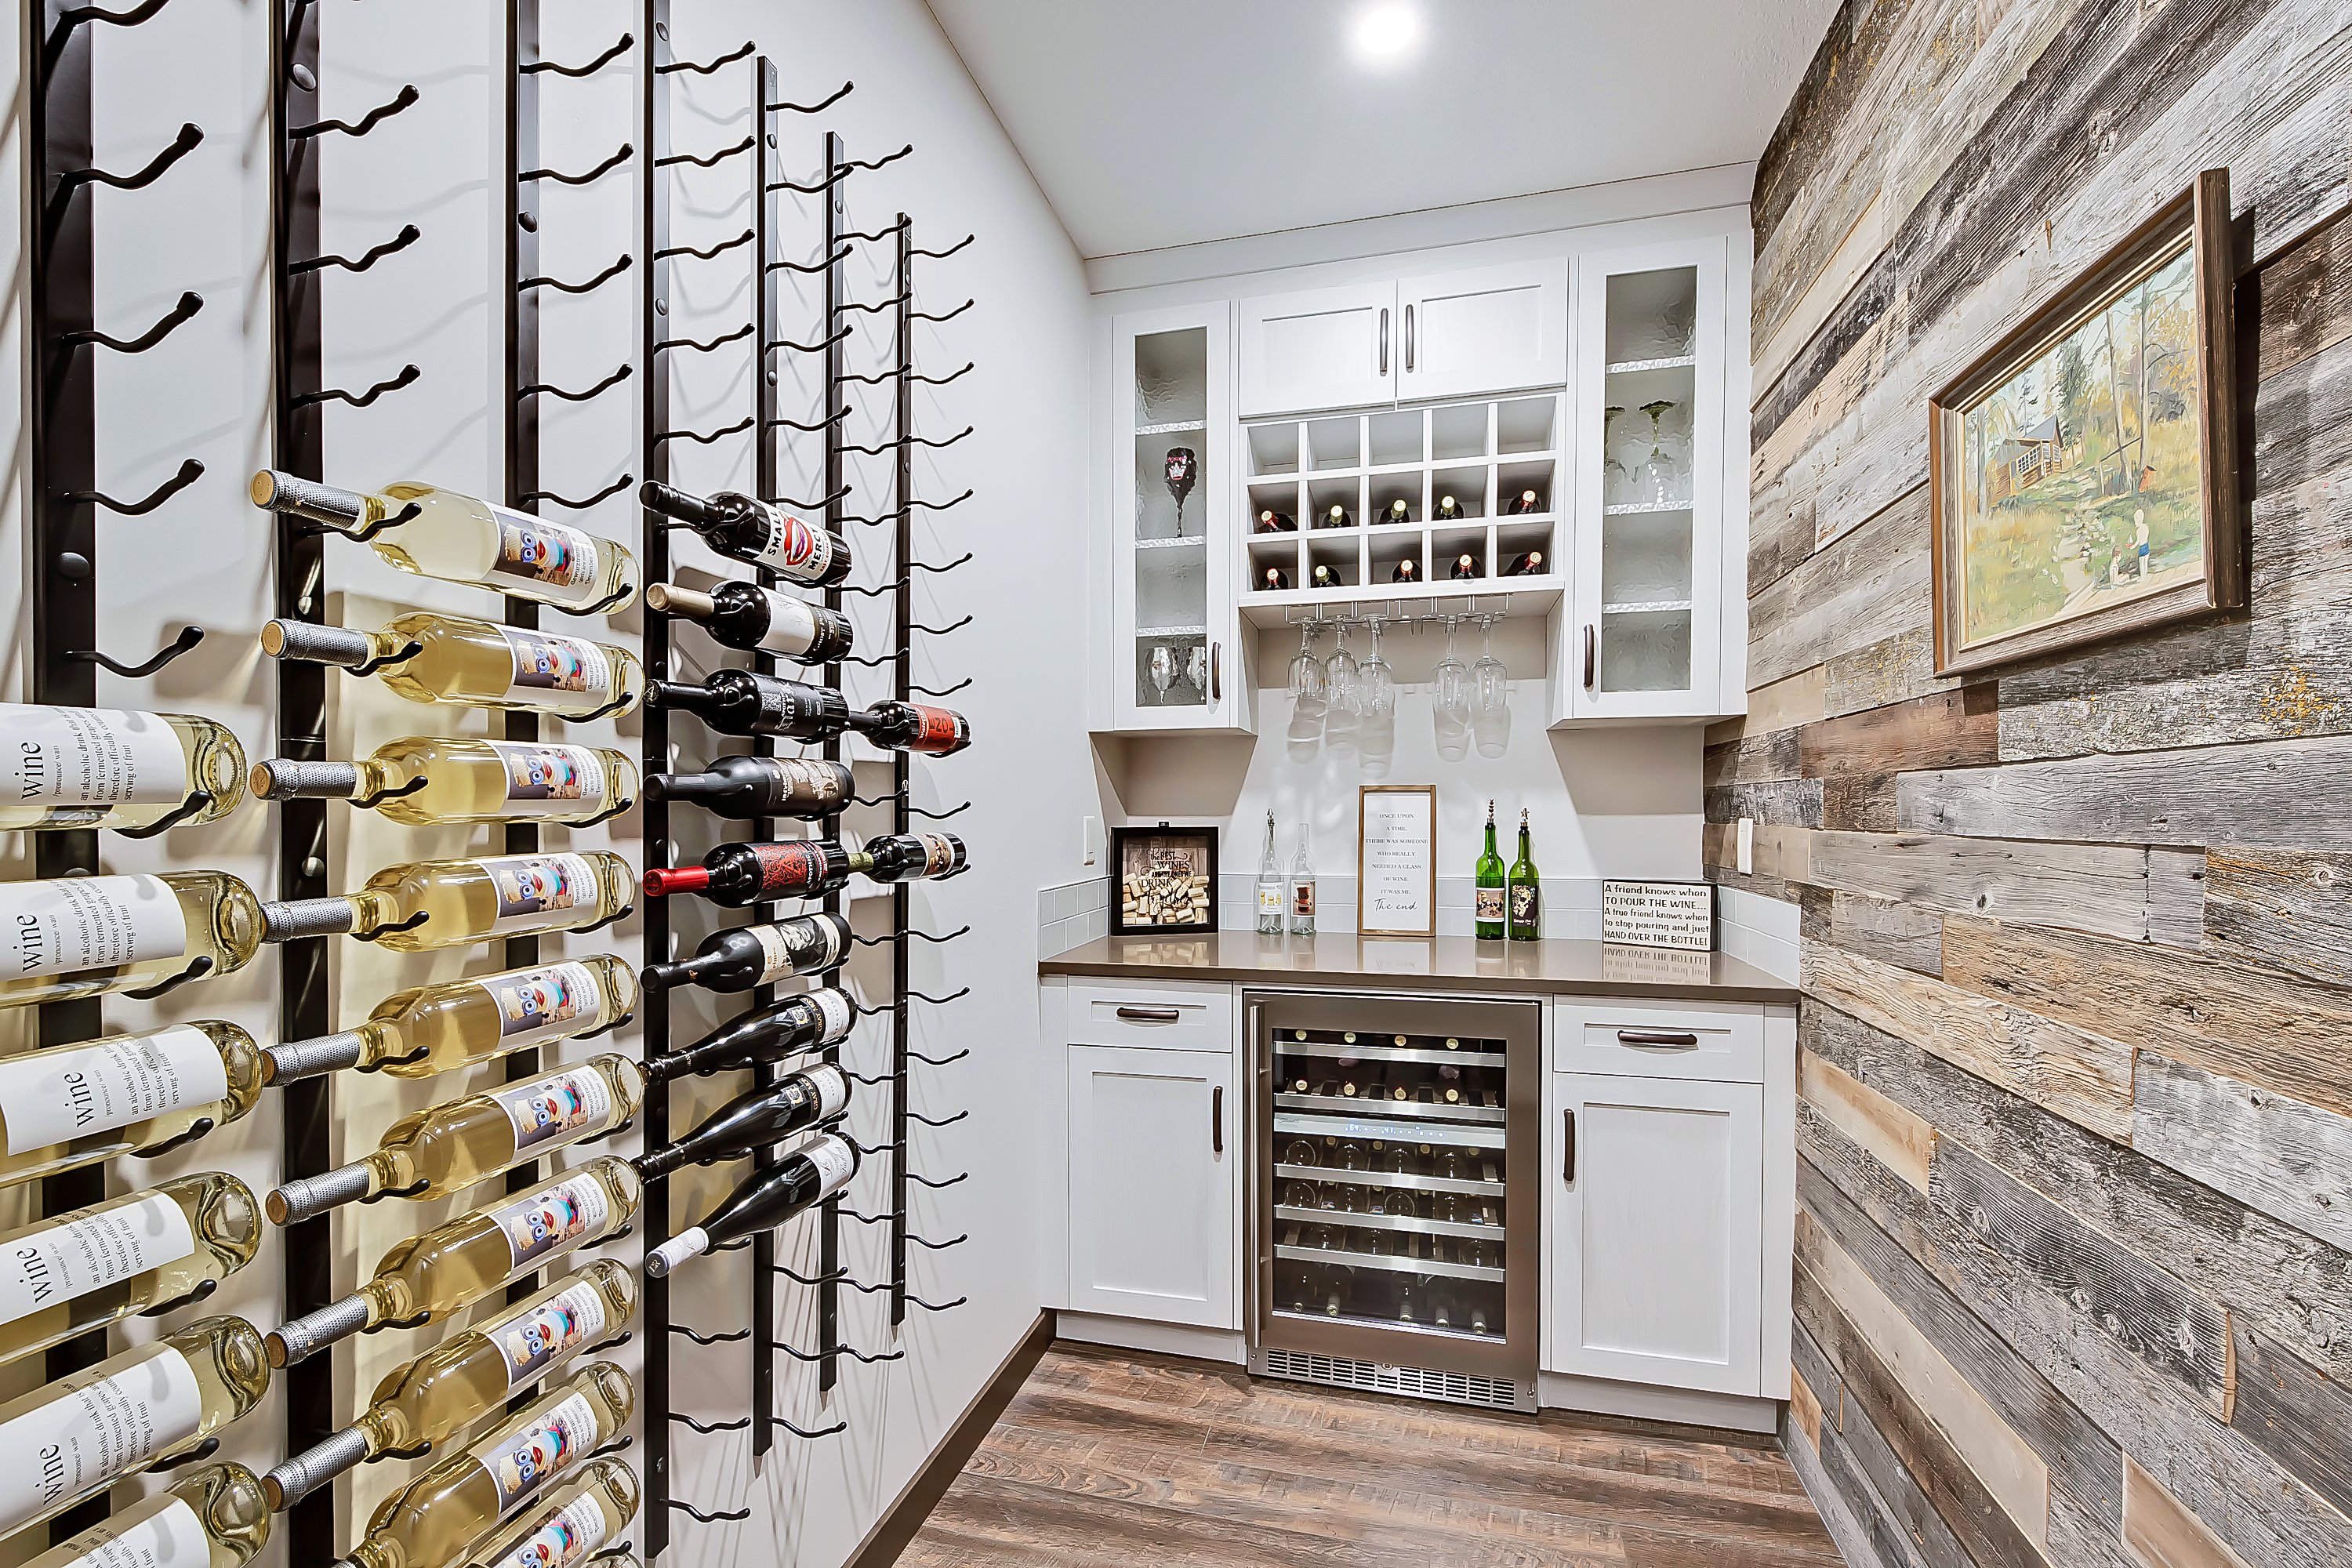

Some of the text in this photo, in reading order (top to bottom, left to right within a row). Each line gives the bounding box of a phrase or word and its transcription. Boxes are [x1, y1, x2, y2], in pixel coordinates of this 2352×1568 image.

[768, 511, 782, 556] SMALL
[808, 527, 822, 570] MERCY
[14, 742, 44, 800] wine
[74, 733, 90, 800] an alcoholic drink
[91, 742, 106, 780] fermented
[103, 732, 120, 800] therefore officially
[122, 745, 136, 800] serving of fruit
[53, 760, 62, 797] /pronounce/
[93, 782, 106, 800] from
[1160, 851, 1181, 860] BEST
[1142, 879, 1172, 887] DRINK
[1614, 884, 1642, 894] friend
[1645, 886, 1676, 895] knows
[1679, 888, 1707, 897] when
[1374, 898, 1417, 911] The end
[1620, 897, 1646, 906] POUR
[1649, 899, 1668, 908] THE
[1670, 900, 1707, 909] WINE...
[1631, 909, 1653, 917] friend
[1656, 910, 1682, 920] knows
[1685, 912, 1708, 921] when
[69, 899, 90, 966] an alcoholic drink
[87, 906, 105, 943] fermented
[99, 896, 120, 962] therefore officially
[118, 905, 136, 960] serving of fruit
[1605, 931, 1708, 946] HAND OVER THE BOTTLE!
[1615, 920, 1633, 929] stop
[1636, 922, 1668, 931] pouring
[1690, 925, 1709, 934] just
[13, 913, 43, 972] wine
[95, 946, 105, 964] from
[585, 978, 594, 1006] December
[122, 1070, 138, 1105] alcoholic
[128, 1057, 153, 1112] from fermented
[155, 1076, 165, 1109] therefore
[158, 1053, 180, 1105] serving of fruit
[64, 1072, 95, 1128] wine
[132, 1105, 139, 1116] an
[597, 1083, 605, 1111] December
[593, 1189, 603, 1217] December
[79, 1240, 100, 1273] alcoholic
[87, 1225, 115, 1279] from fermented
[115, 1240, 129, 1274] therefore
[116, 1218, 143, 1268] serving of fruit
[16, 1247, 53, 1304] wine
[93, 1273, 100, 1284] an
[590, 1298, 600, 1325] December
[89, 1410, 104, 1430] drink
[118, 1396, 136, 1429] officially
[137, 1401, 154, 1457] serving of fruit
[583, 1413, 591, 1442] December
[107, 1413, 124, 1451] fermented
[128, 1430, 138, 1464] therefore
[99, 1432, 109, 1468] alcoholic
[112, 1452, 123, 1472] from
[34, 1444, 64, 1505] wine
[100, 1468, 107, 1478] an
[586, 1505, 599, 1533] December
